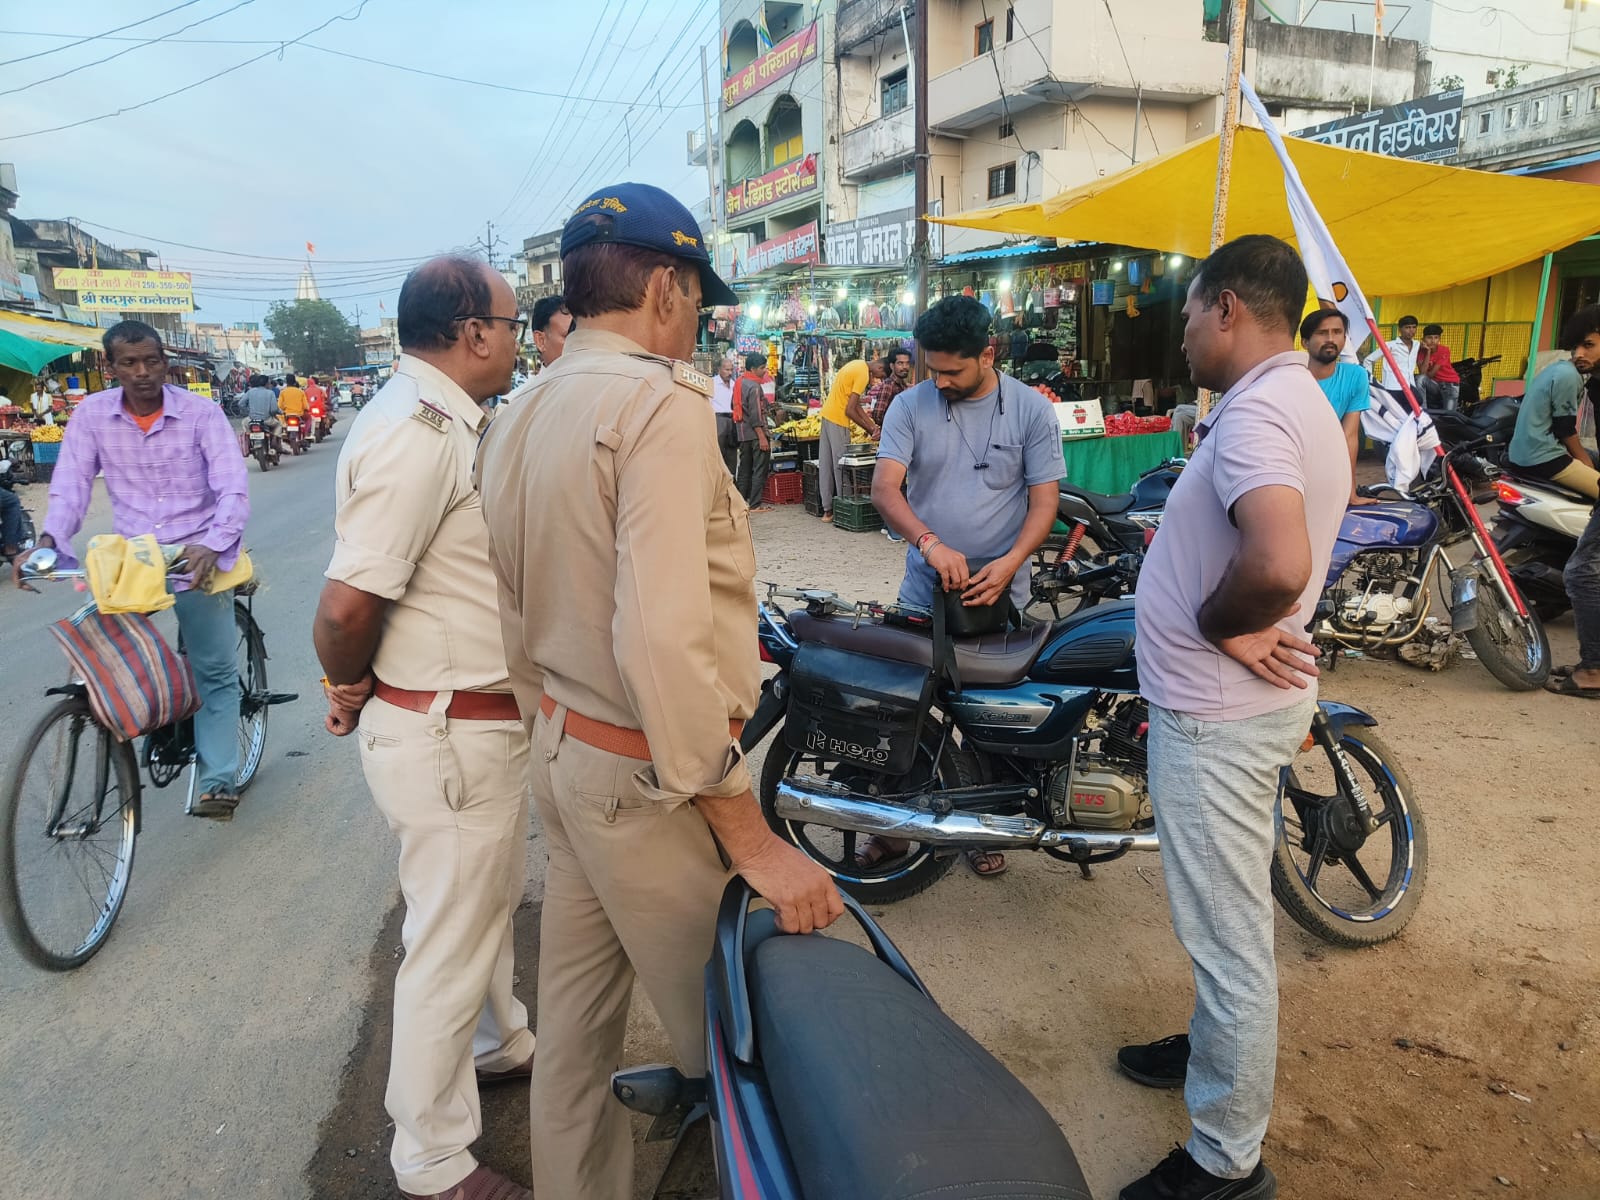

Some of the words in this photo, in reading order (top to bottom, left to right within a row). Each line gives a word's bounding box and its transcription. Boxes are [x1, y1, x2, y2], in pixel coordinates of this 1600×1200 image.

[742, 64, 756, 90] श्री
[759, 42, 800, 78] परिधान
[1378, 108, 1462, 154] हार्डवेयर
[726, 191, 741, 214] जैन
[860, 222, 903, 264] जनरल
[81, 292, 97, 305] श्री
[829, 738, 889, 762] Hero
[1073, 792, 1106, 807] TVS
